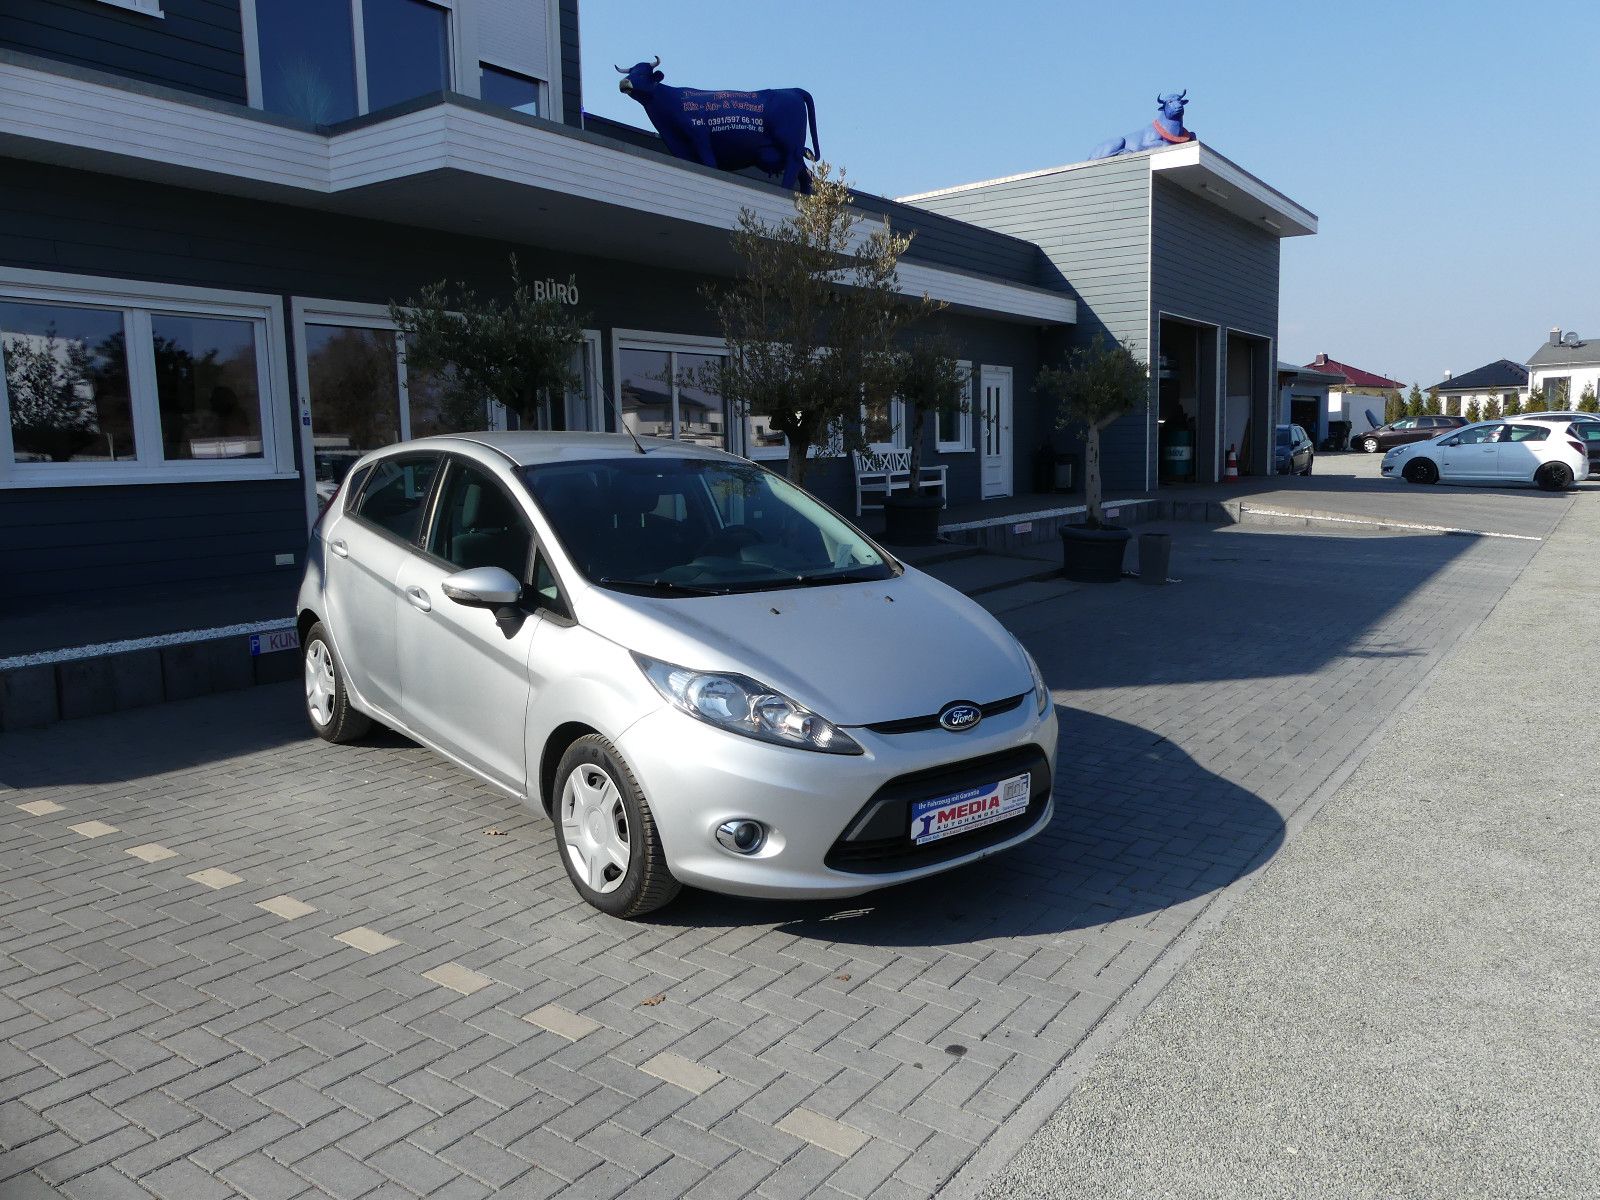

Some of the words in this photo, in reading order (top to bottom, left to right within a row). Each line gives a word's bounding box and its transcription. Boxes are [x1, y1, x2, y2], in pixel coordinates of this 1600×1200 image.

[691, 118, 706, 126] Tel.
[708, 115, 740, 126] 0391/597
[751, 118, 763, 126] 100
[534, 278, 579, 305] BÜRO
[270, 630, 299, 649] KUN
[952, 709, 975, 725] Ford
[918, 802, 927, 810] Ihr
[927, 797, 951, 808] Fahrzeug
[951, 794, 960, 802] mit
[960, 789, 980, 799] Garantie
[936, 795, 1000, 824] MEDIA
[936, 809, 1000, 831] AUTOHANDEL
